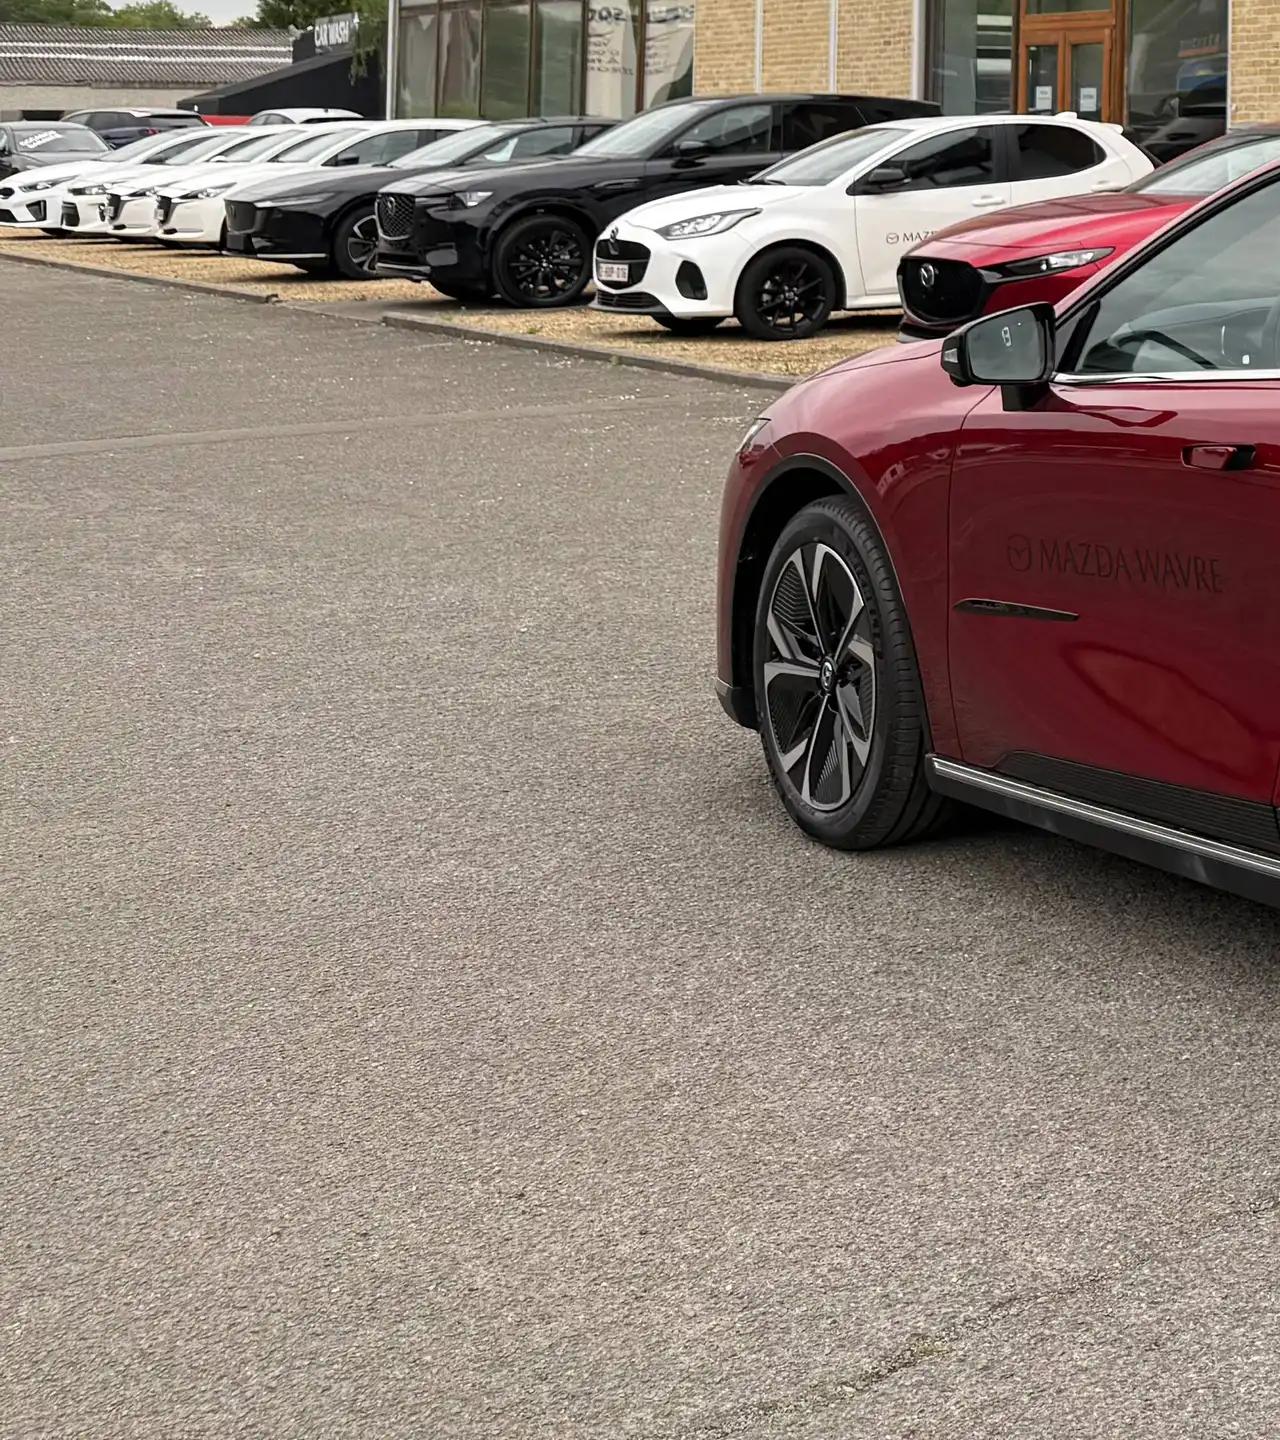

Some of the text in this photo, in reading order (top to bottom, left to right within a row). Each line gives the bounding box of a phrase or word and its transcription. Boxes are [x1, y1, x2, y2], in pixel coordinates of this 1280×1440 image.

[314, 19, 349, 48] CAR WASH
[1039, 538, 1224, 594] MAZDA WAVRE
